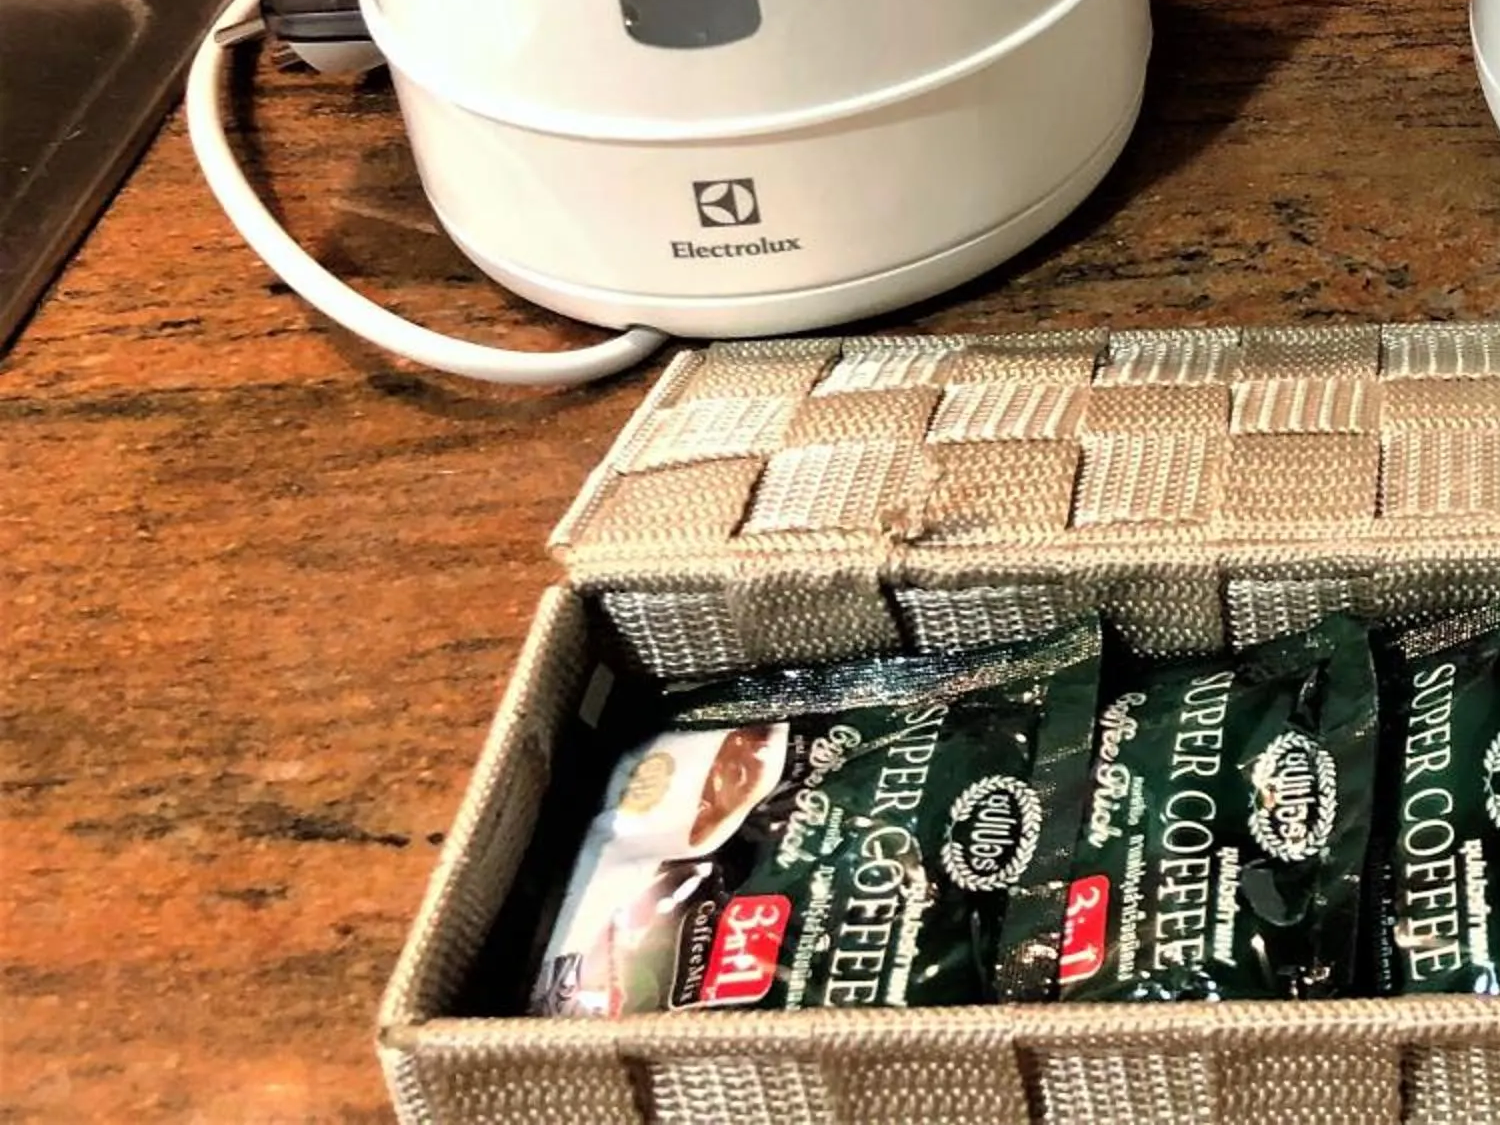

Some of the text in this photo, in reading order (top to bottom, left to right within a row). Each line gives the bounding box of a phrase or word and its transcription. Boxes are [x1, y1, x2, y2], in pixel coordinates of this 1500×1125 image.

[670, 236, 803, 259] Electrolux
[822, 704, 948, 1007] SUPER COFFEE
[1087, 691, 1147, 848] Coffee Rich
[1154, 671, 1236, 974] SUPER COFFEE
[1404, 663, 1461, 981] SUPER COFFEE
